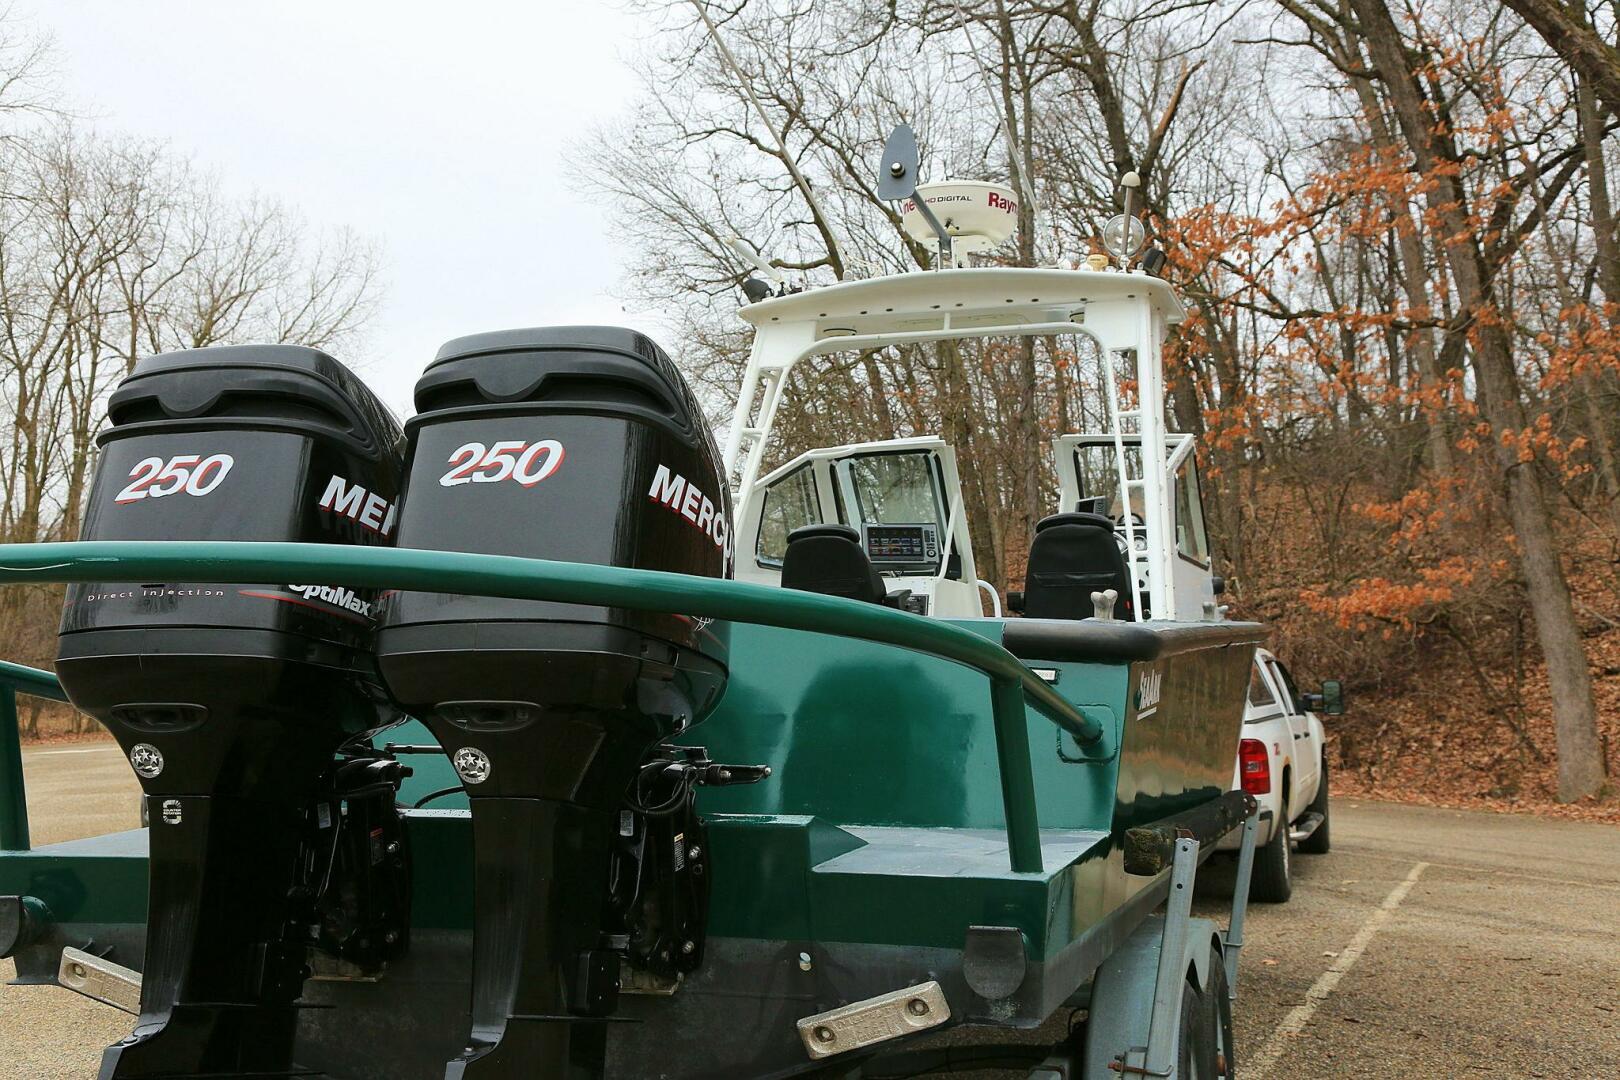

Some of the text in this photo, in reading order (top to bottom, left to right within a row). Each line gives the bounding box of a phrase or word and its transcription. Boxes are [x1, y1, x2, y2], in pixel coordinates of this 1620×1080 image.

[937, 195, 973, 203] DIGITAL
[114, 453, 235, 505] 250
[439, 439, 566, 488] 250
[87, 588, 224, 602] Direct Injection
